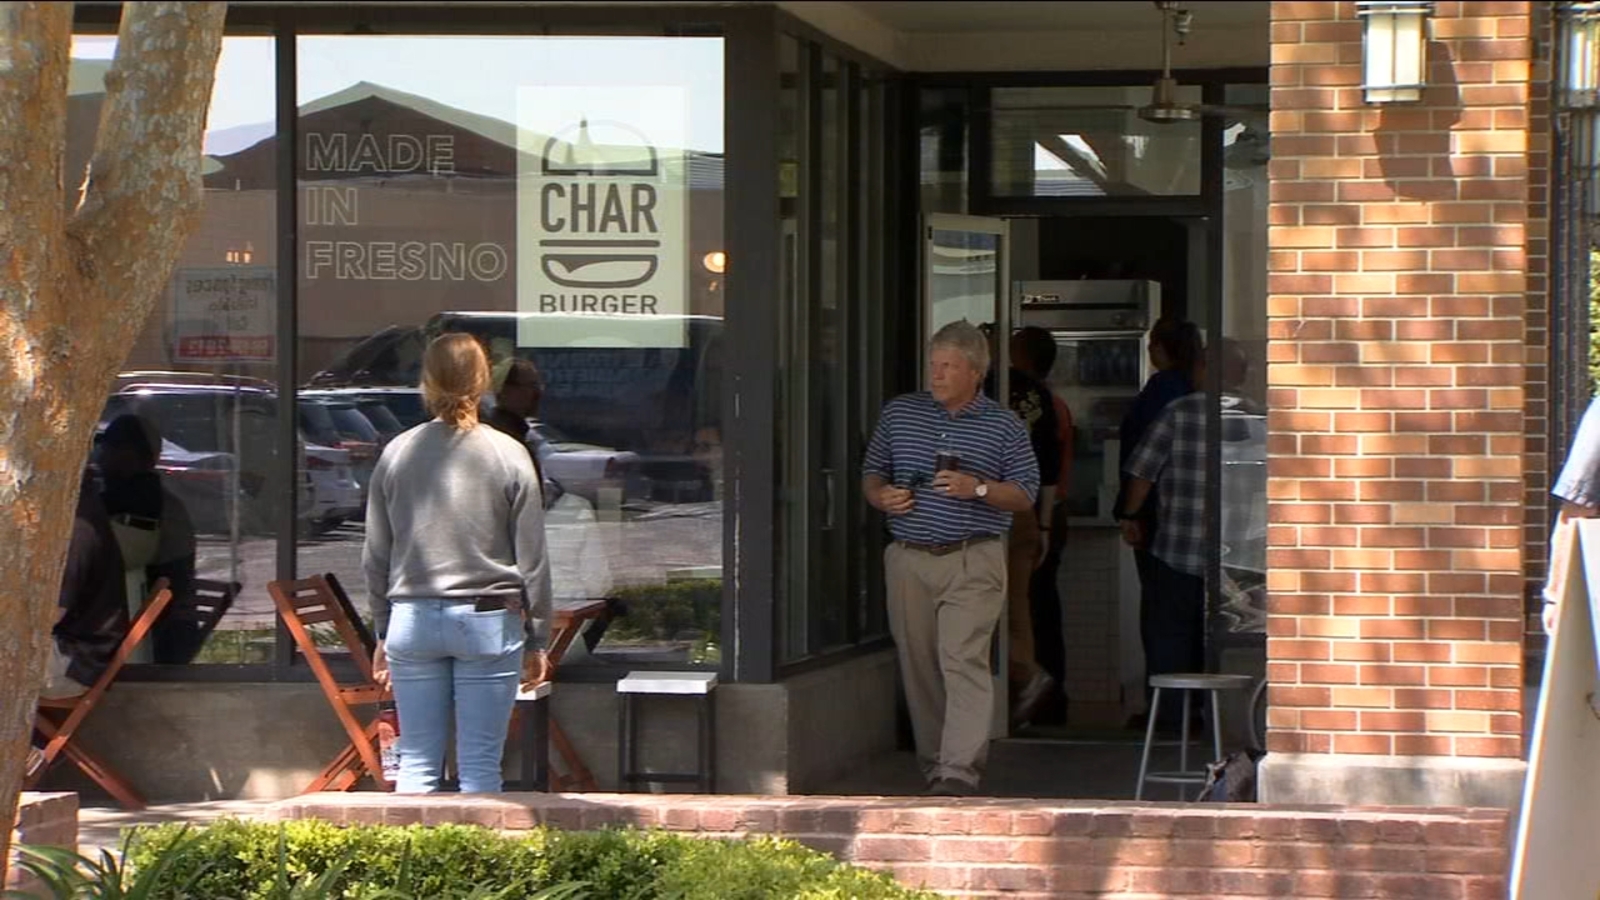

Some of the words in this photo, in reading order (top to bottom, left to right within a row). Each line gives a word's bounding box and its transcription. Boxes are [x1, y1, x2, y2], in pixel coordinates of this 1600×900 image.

[306, 133, 455, 172] MADE
[306, 187, 358, 225] IN
[540, 183, 658, 233] CHAR
[306, 242, 507, 281] FRESNO
[540, 294, 657, 314] BURGER
